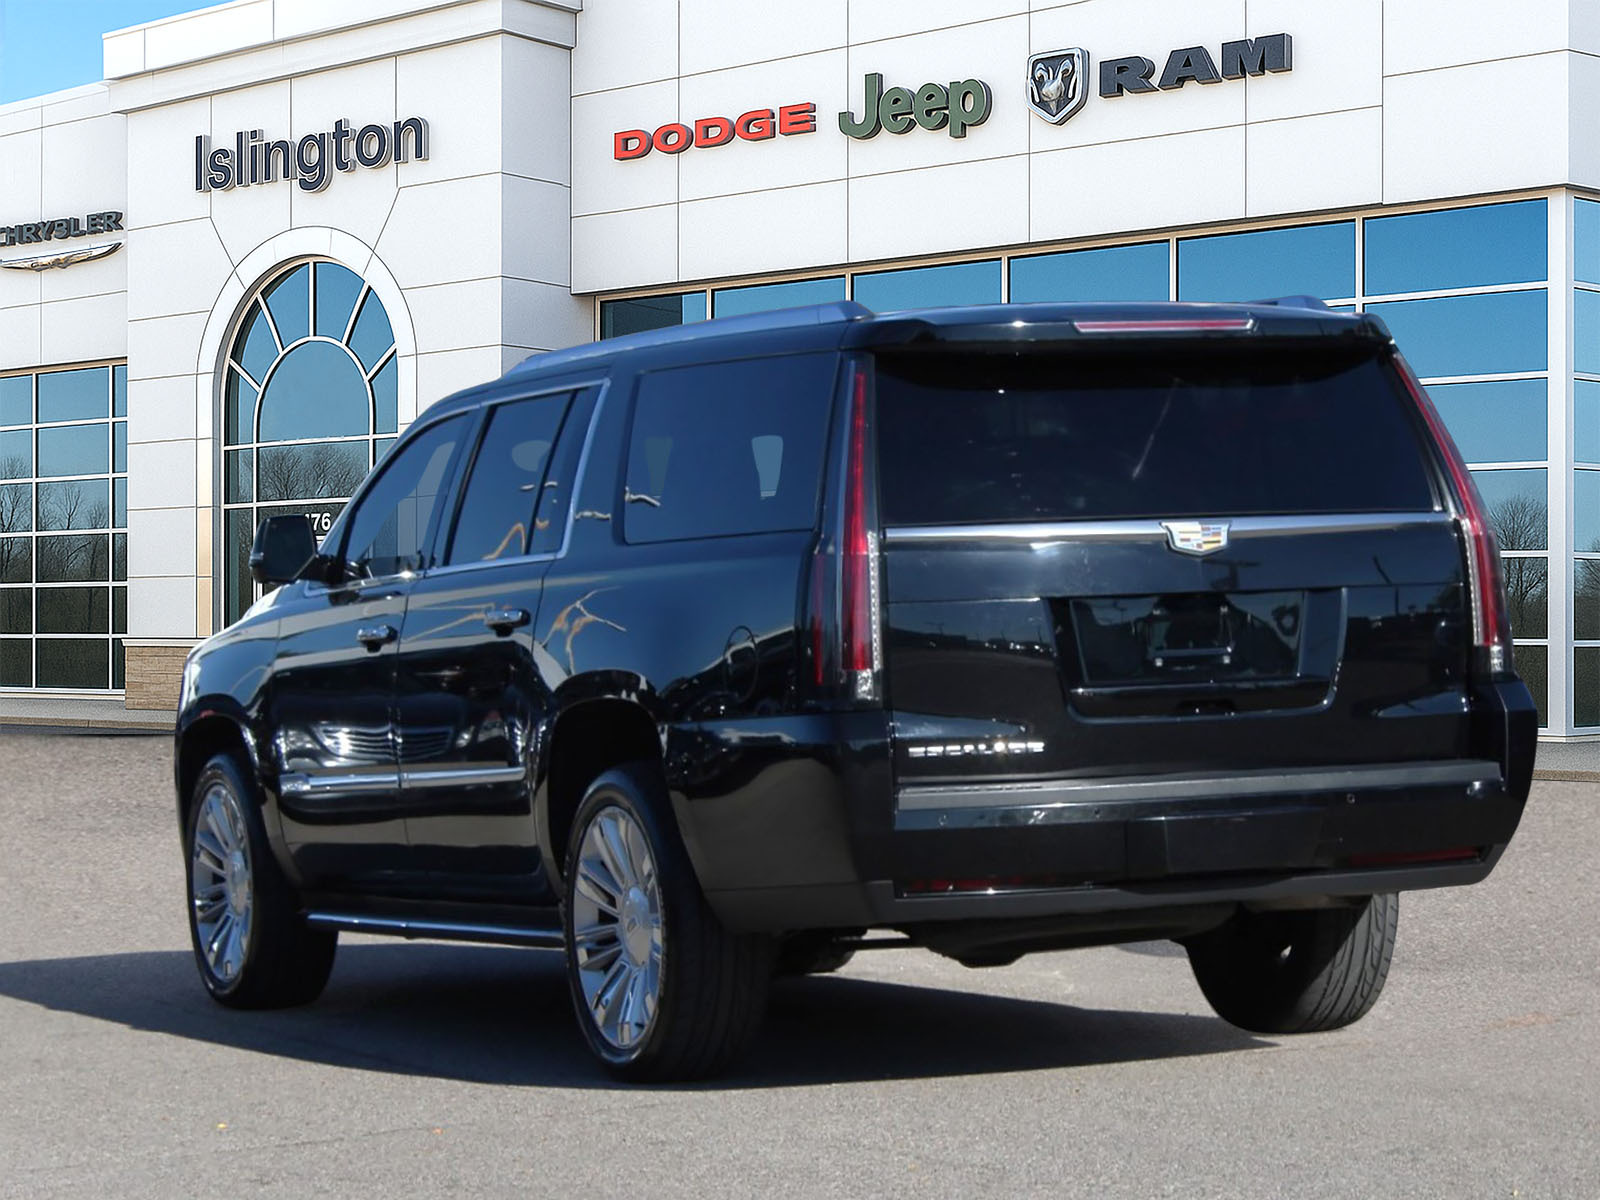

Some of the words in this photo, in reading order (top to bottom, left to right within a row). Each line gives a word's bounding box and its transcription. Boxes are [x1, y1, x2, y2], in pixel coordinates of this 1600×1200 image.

[1099, 33, 1293, 98] RAM
[614, 102, 816, 161] DODGE
[838, 72, 992, 139] Jeep
[195, 116, 430, 193] Islington
[305, 513, 331, 531] 76
